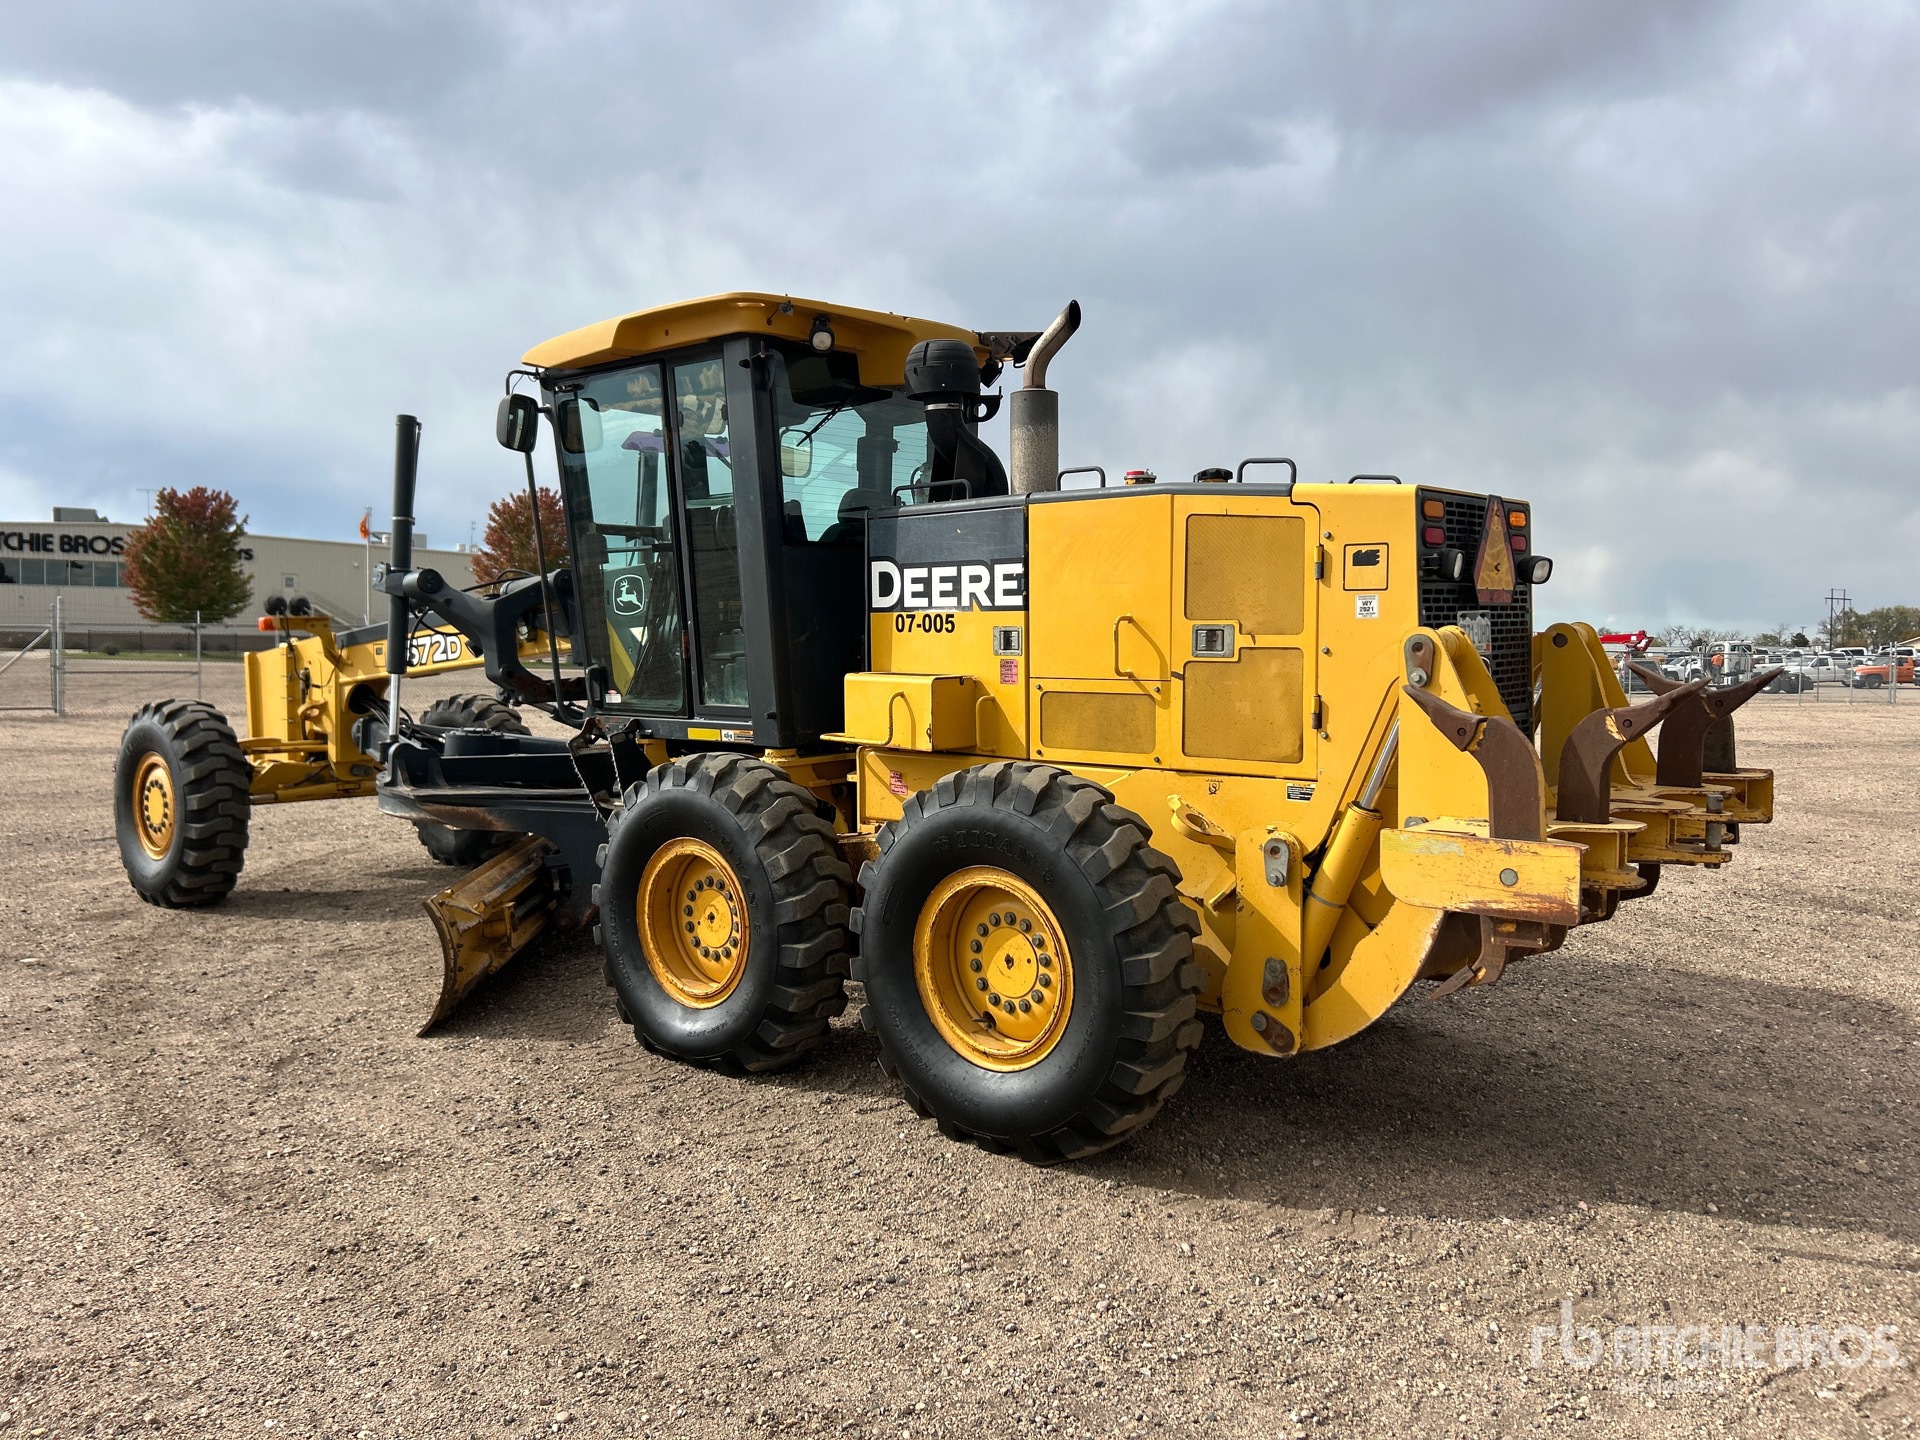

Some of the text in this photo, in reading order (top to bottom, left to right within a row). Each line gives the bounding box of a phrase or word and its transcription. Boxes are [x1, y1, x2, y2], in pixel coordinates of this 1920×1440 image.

[871, 560, 1024, 608] DEERE
[895, 613, 956, 634] 07-005
[954, 829, 1034, 866] TITAN
